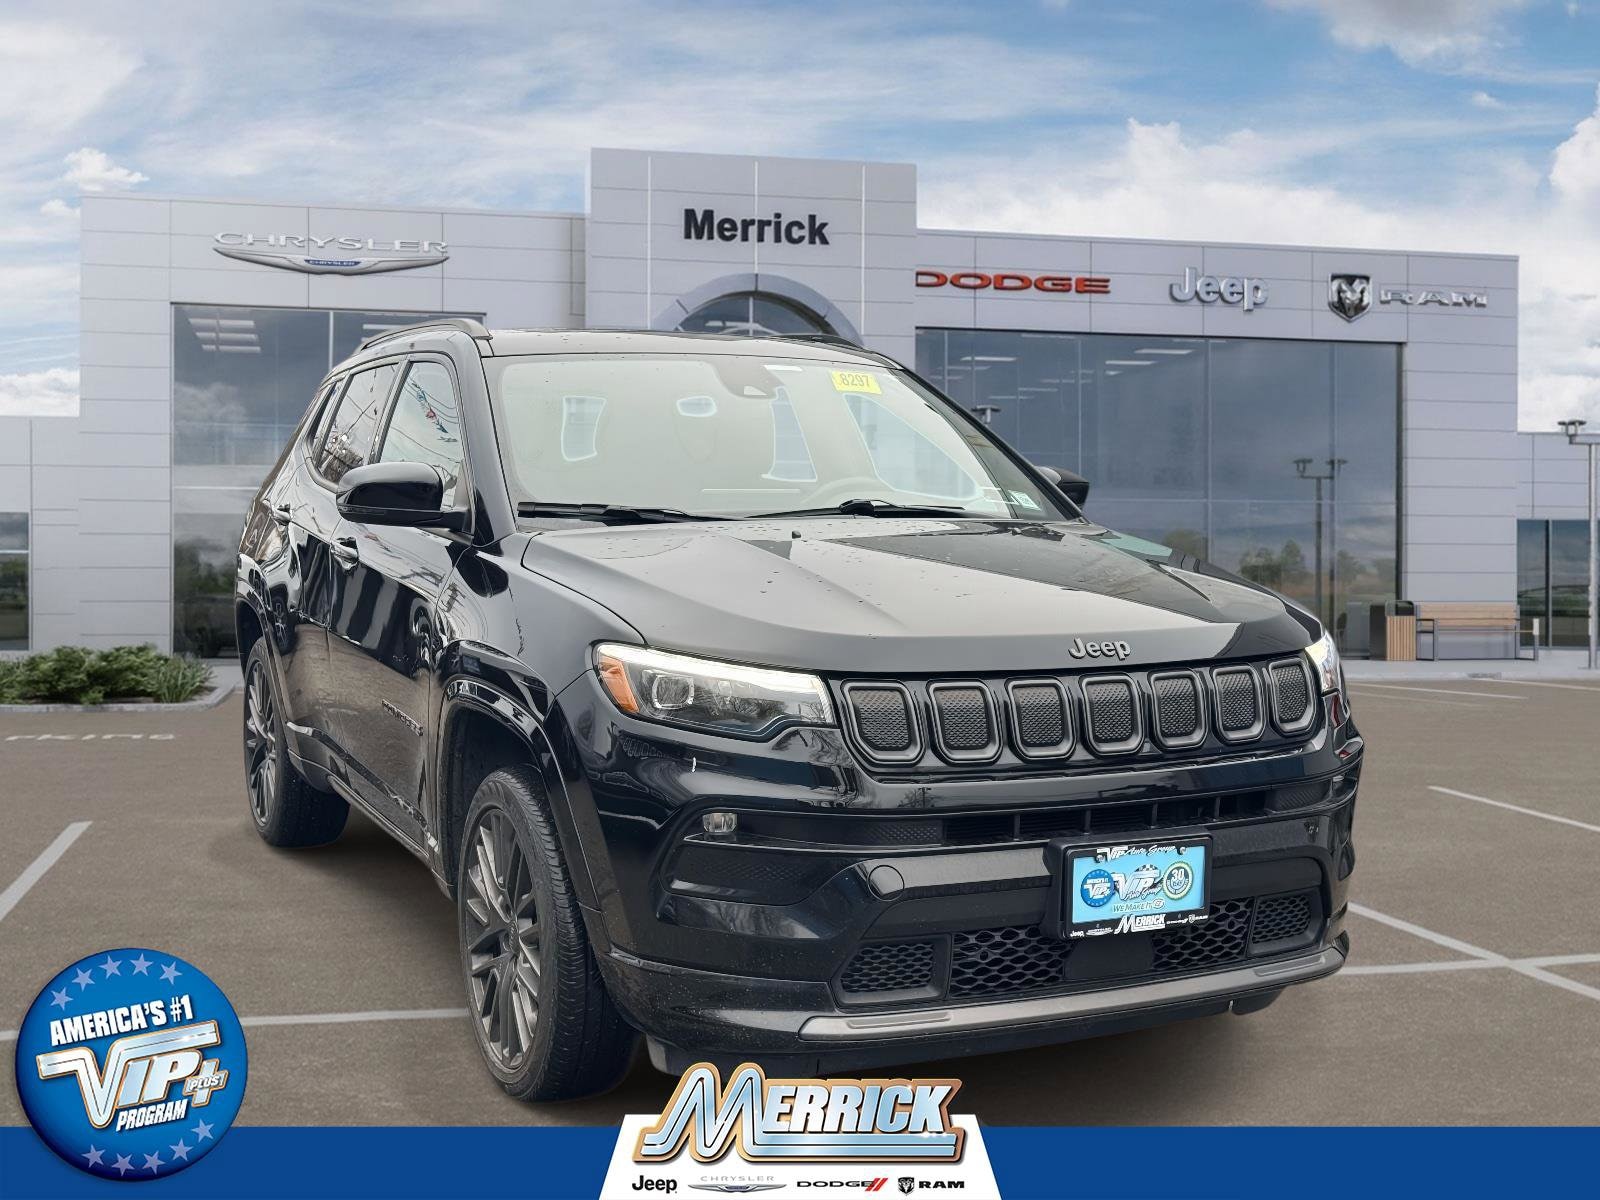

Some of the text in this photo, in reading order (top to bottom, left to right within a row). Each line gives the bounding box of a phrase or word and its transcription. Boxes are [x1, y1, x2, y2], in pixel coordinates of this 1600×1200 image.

[684, 208, 830, 245] Merrick
[215, 232, 449, 253] CHRYSLER
[915, 270, 1111, 294] DODGE
[1170, 267, 1268, 311] Jeep
[1379, 289, 1487, 308] RAM
[1068, 637, 1131, 661] Jeep
[1171, 868, 1185, 881] 30
[1114, 914, 1167, 935] MERRICK
